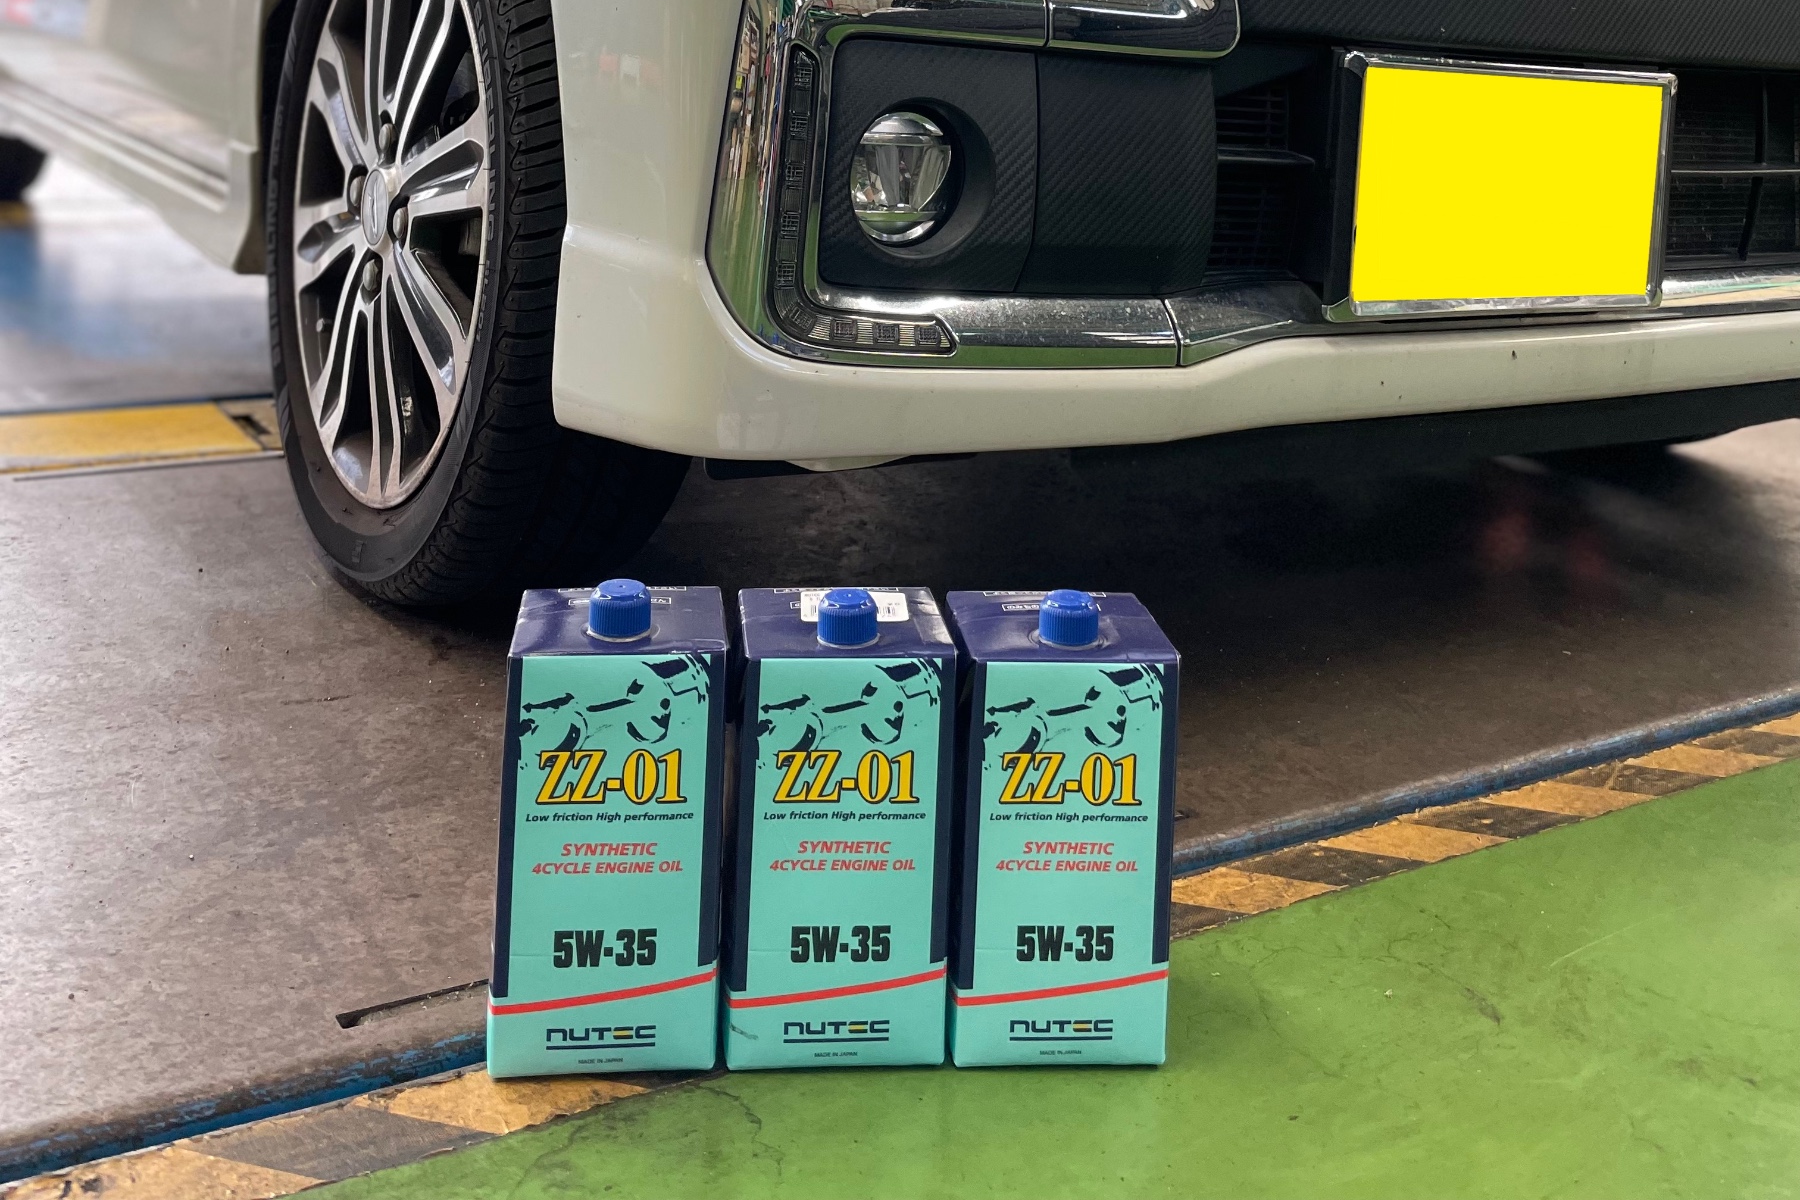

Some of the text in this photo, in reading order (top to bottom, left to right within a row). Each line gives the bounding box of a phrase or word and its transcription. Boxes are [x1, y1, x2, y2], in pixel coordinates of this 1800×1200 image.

[536, 749, 687, 805] ZZ-01
[773, 749, 920, 805] ZZ-01
[998, 751, 1142, 806] ZZ-01
[525, 812, 694, 824] Low friction High performance
[763, 810, 926, 822] Low friction High performance
[989, 812, 1148, 824] Low friction High performance
[561, 842, 658, 857] SYNTHETIC
[797, 841, 891, 854] SYNTHETIC
[1022, 841, 1114, 856] SYNTHETIC
[531, 860, 683, 875] 4CYCLE ENGINE OIL
[769, 859, 915, 871] 4CYCLE ENGINE OIL
[995, 859, 1138, 872] 4CYCLE ENGINE OIL
[553, 928, 658, 969] 5W-35
[790, 925, 891, 963] 5W-35
[1016, 925, 1115, 962] 5W-35
[545, 1025, 656, 1042] NUTEC
[783, 1020, 890, 1036] NUTEC
[1009, 1019, 1113, 1033] NUTEC
